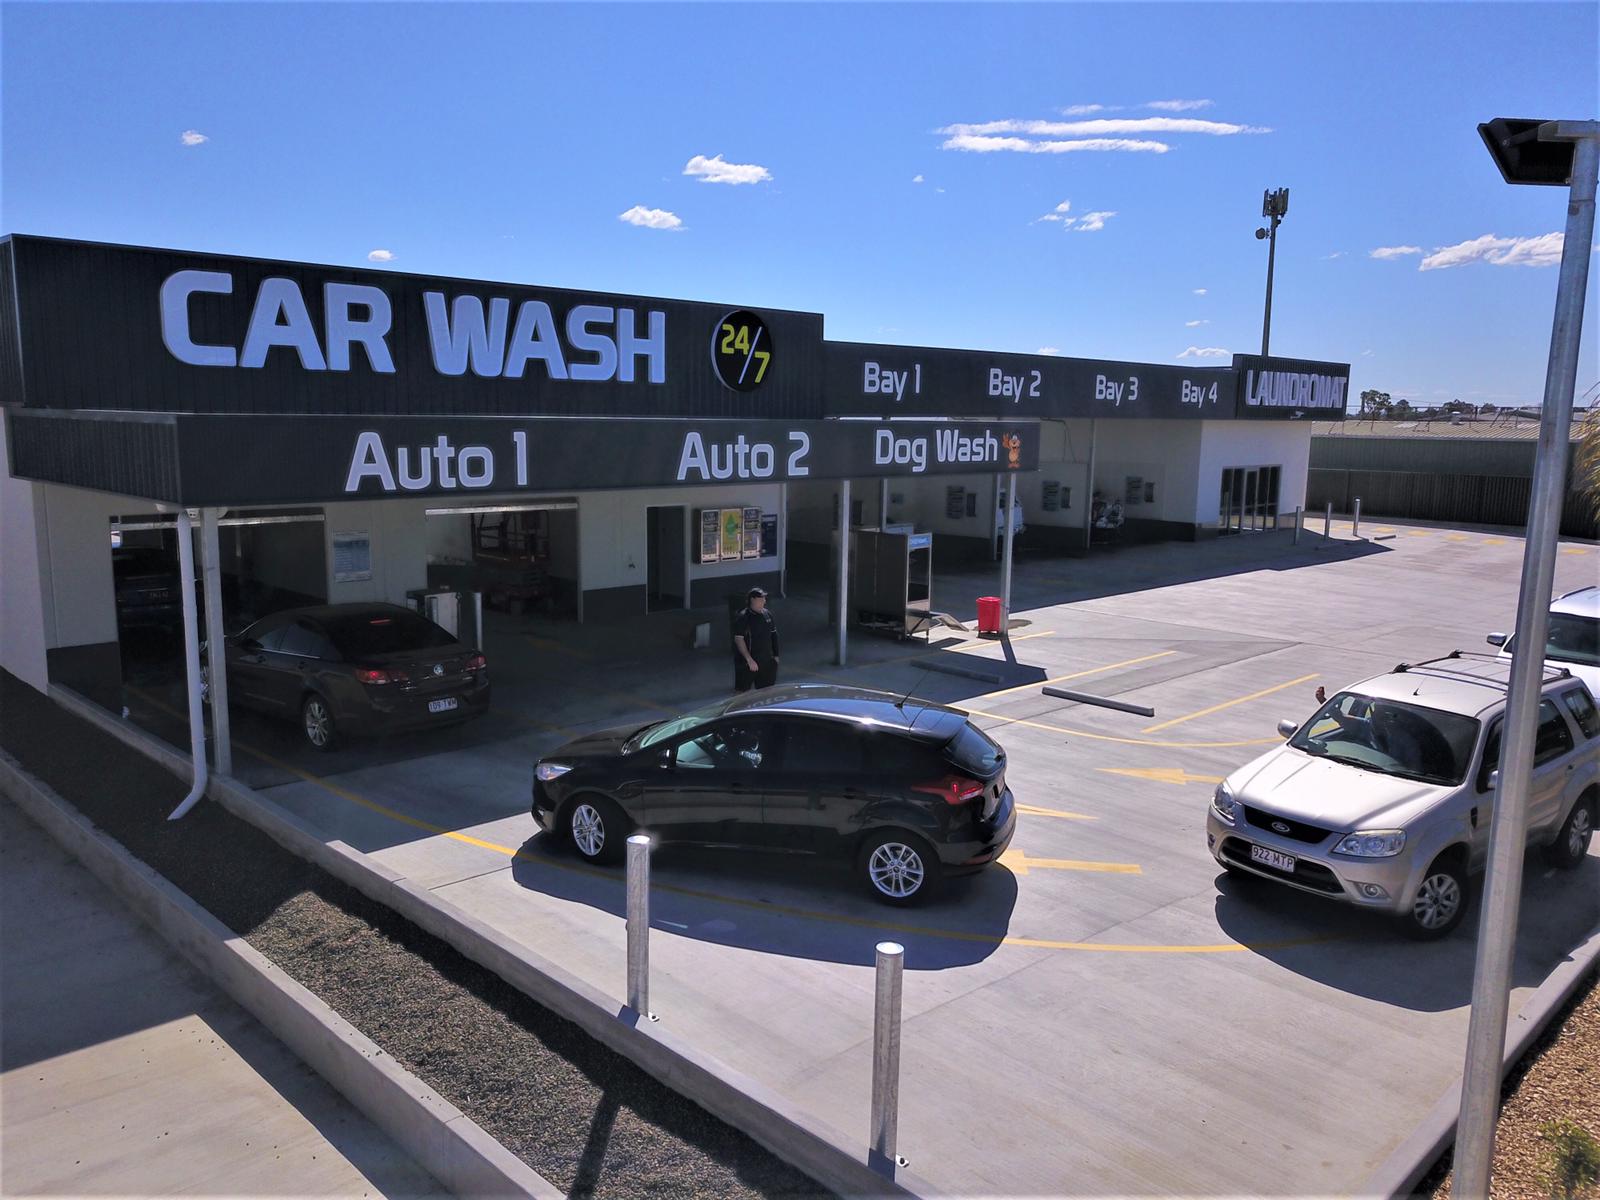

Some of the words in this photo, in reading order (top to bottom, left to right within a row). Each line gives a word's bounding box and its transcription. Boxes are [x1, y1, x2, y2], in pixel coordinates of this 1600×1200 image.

[159, 269, 396, 373] CAR
[422, 291, 666, 384] WASH
[721, 324, 770, 384] 24/7
[864, 361, 908, 401] Bay
[914, 363, 921, 394] 1
[989, 367, 1024, 403] Bay
[1030, 370, 1041, 397] 2
[1095, 374, 1125, 407] Bay
[1128, 376, 1139, 401] 3
[1181, 379, 1206, 408] Bay
[1208, 381, 1218, 404] 4
[1245, 369, 1348, 409] LAUNDROMAT
[344, 430, 494, 493] Auto
[513, 431, 528, 486] 1
[676, 431, 775, 481] Auto
[787, 431, 810, 476] 2
[875, 429, 927, 473] Dog
[935, 428, 998, 463] Wash
